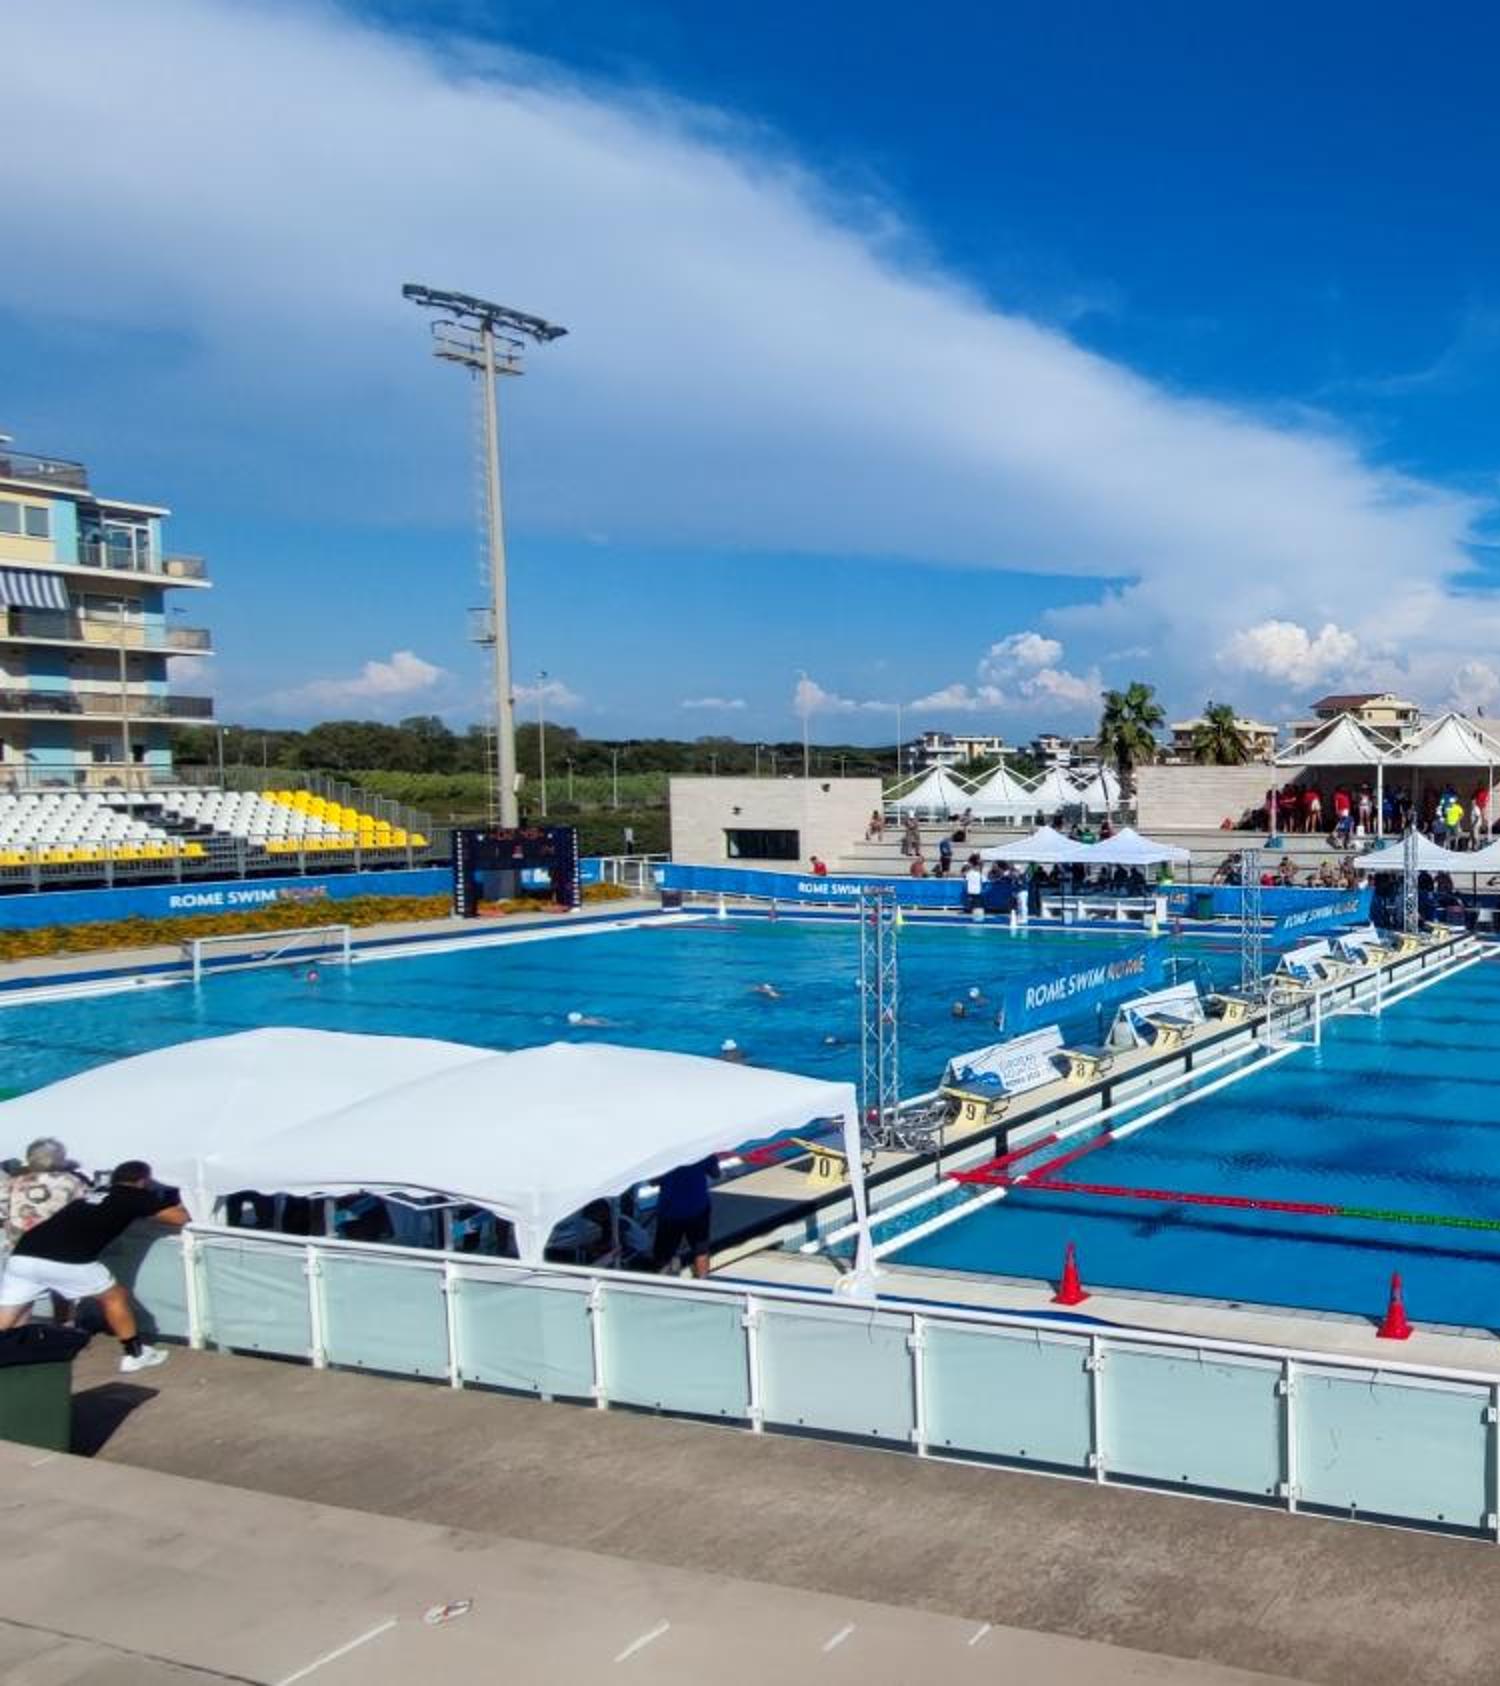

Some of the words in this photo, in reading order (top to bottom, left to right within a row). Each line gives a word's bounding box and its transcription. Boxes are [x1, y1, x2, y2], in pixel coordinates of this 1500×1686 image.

[169, 892, 224, 908] ROME
[227, 889, 277, 904] SWIM
[1026, 977, 1067, 1010] ROME
[1067, 965, 1106, 995] SWIM
[965, 1103, 976, 1120] 9
[819, 1157, 830, 1177] 0
